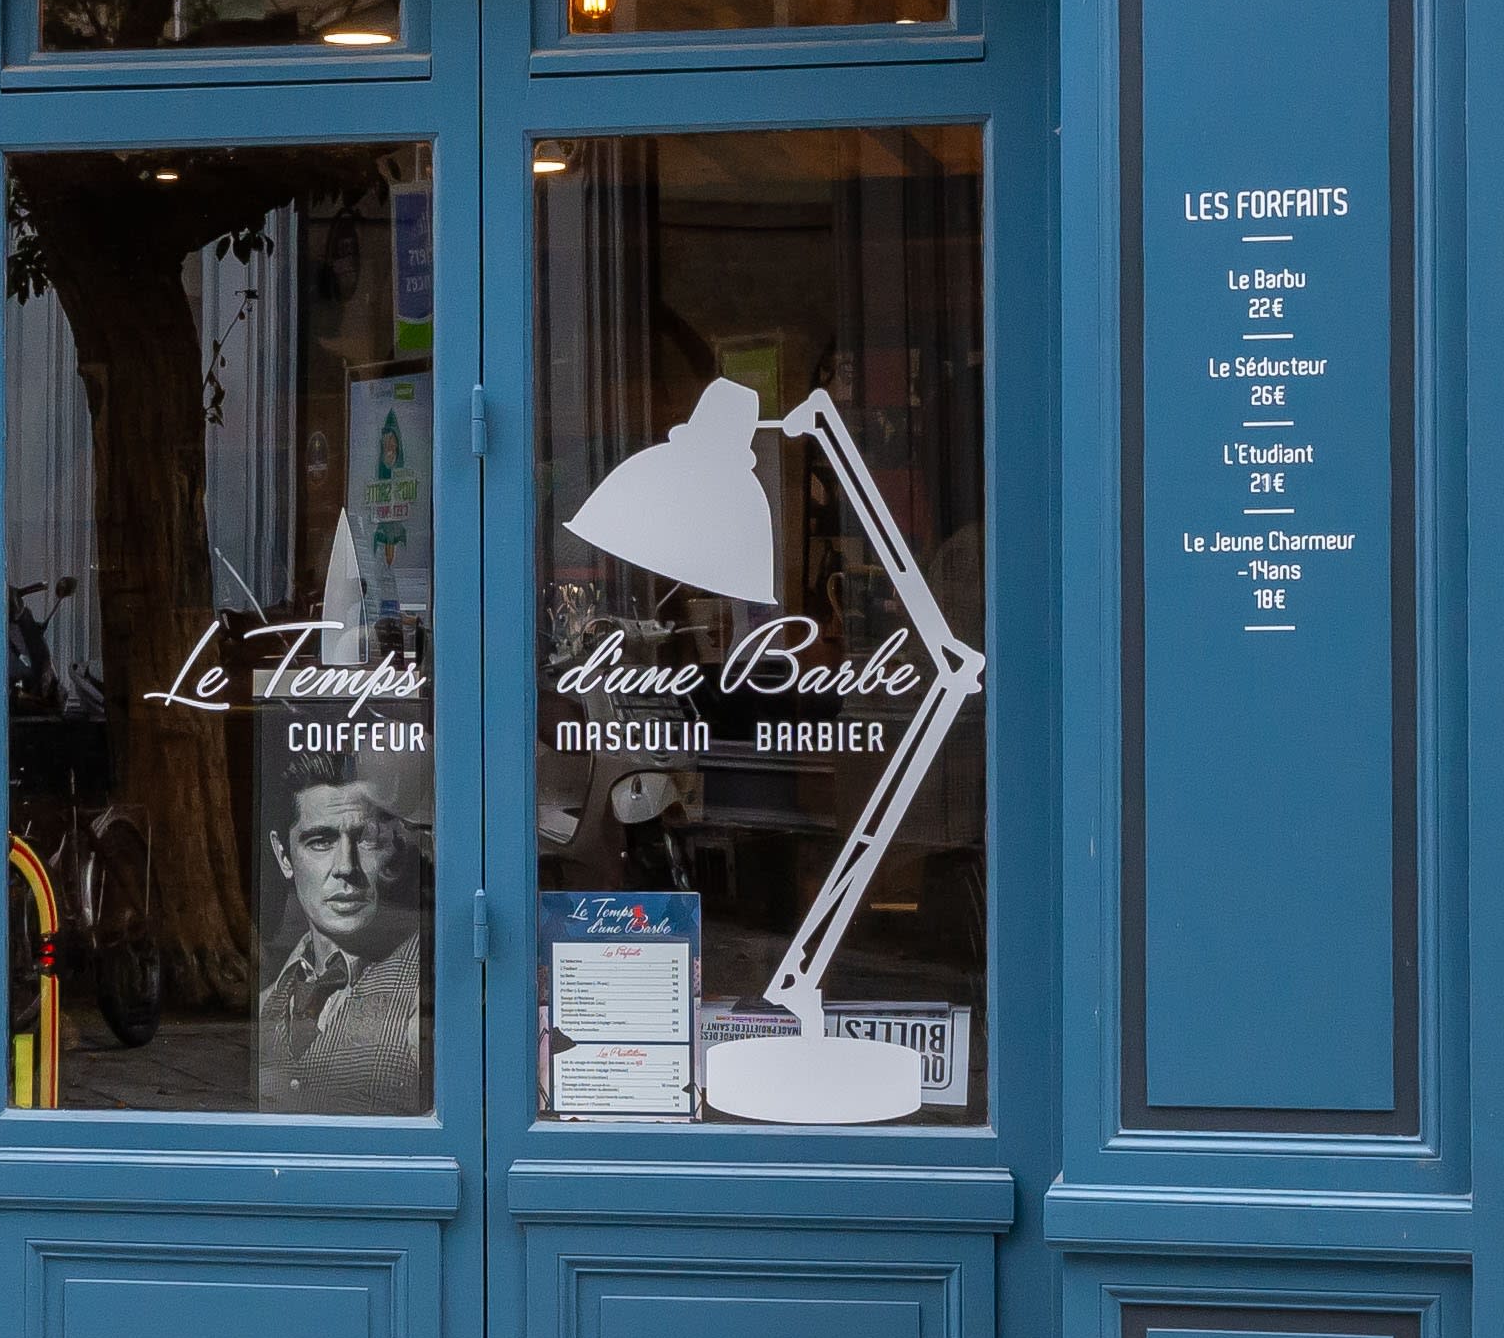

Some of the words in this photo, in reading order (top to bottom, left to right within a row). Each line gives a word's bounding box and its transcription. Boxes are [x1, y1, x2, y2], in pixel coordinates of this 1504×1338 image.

[1185, 191, 1229, 220] LES
[1237, 188, 1348, 219] FORFAITS
[1228, 270, 1250, 290] Le
[1254, 269, 1306, 289] Barbu
[1209, 358, 1230, 378] Le
[1235, 357, 1327, 377] Séducteur
[1224, 443, 1314, 464] L'Etudiant
[1183, 533, 1205, 552] Le
[1210, 532, 1264, 552] Jeune
[1268, 531, 1356, 551] Charmeur
[142, 622, 231, 710] Le
[243, 622, 426, 718] Temps
[557, 629, 704, 695] d'une
[720, 616, 920, 696] Barbe
[288, 721, 426, 753] COIFFEUR
[557, 721, 710, 752] MASCULIN
[757, 722, 885, 752] BARBIER
[567, 898, 588, 921] Le
[592, 898, 634, 922] Temps
[625, 913, 671, 934] Barbe
[845, 1020, 946, 1054] BULLES
